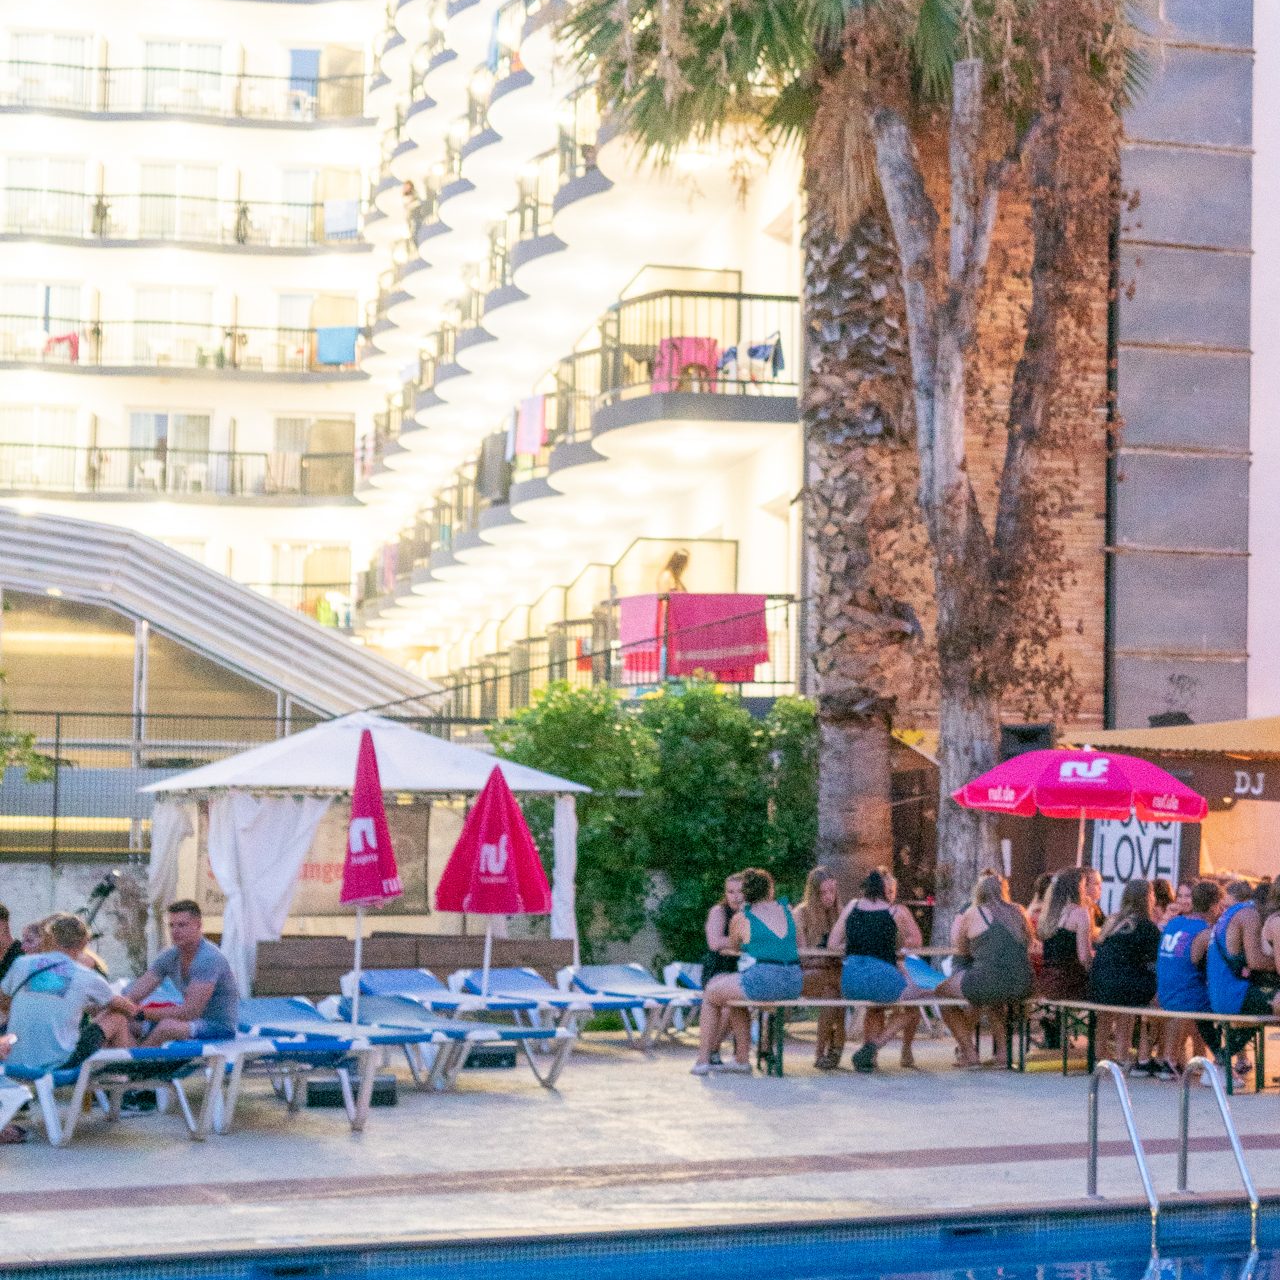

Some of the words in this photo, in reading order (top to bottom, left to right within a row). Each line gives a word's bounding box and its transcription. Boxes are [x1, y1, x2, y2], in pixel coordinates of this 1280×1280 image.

[1059, 758, 1110, 778] ruf
[1234, 770, 1265, 796] DJ
[1099, 833, 1173, 883] LOVE
